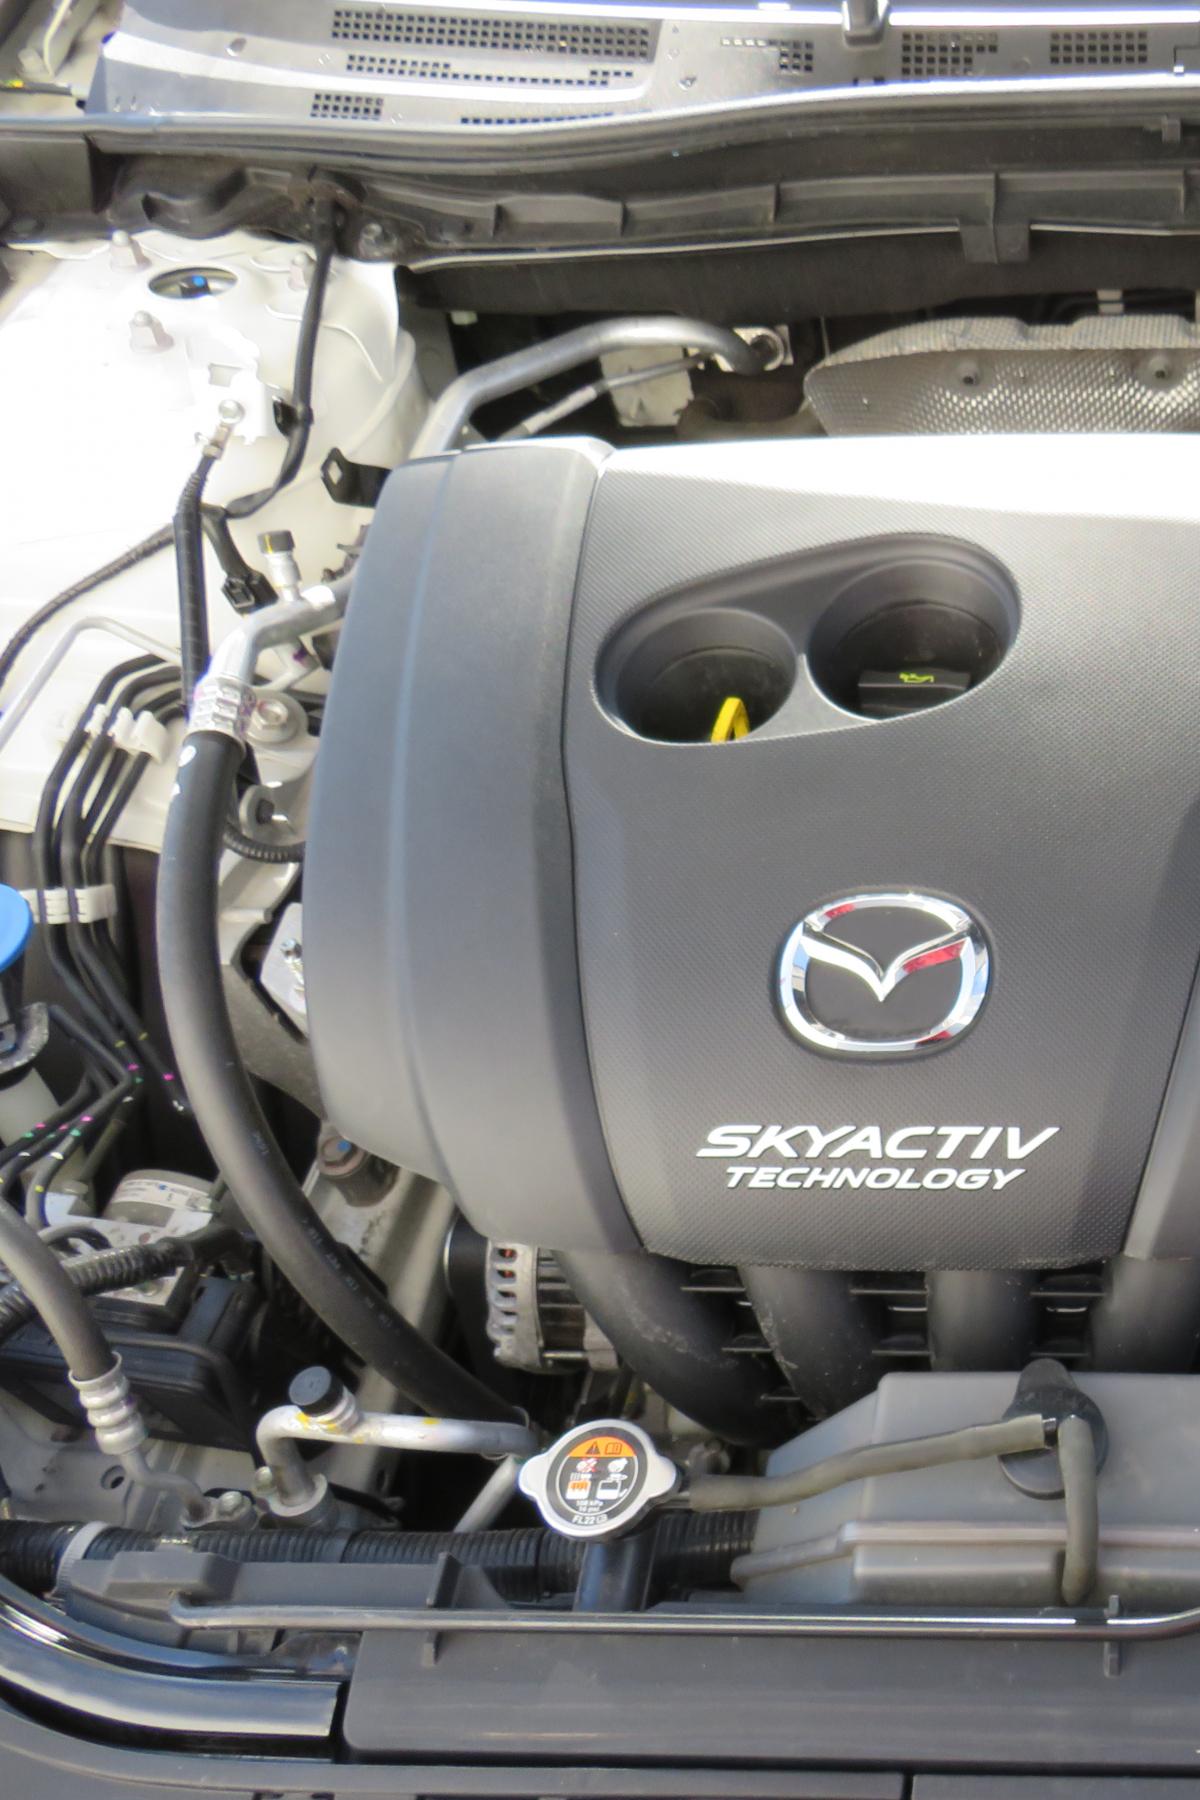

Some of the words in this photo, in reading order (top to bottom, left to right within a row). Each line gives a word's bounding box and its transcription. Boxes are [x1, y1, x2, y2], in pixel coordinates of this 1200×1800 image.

[695, 1123, 1060, 1160] SKYACTIV
[724, 1166, 1029, 1191] TECHNOLOGY
[572, 1514, 596, 1525] FL22
